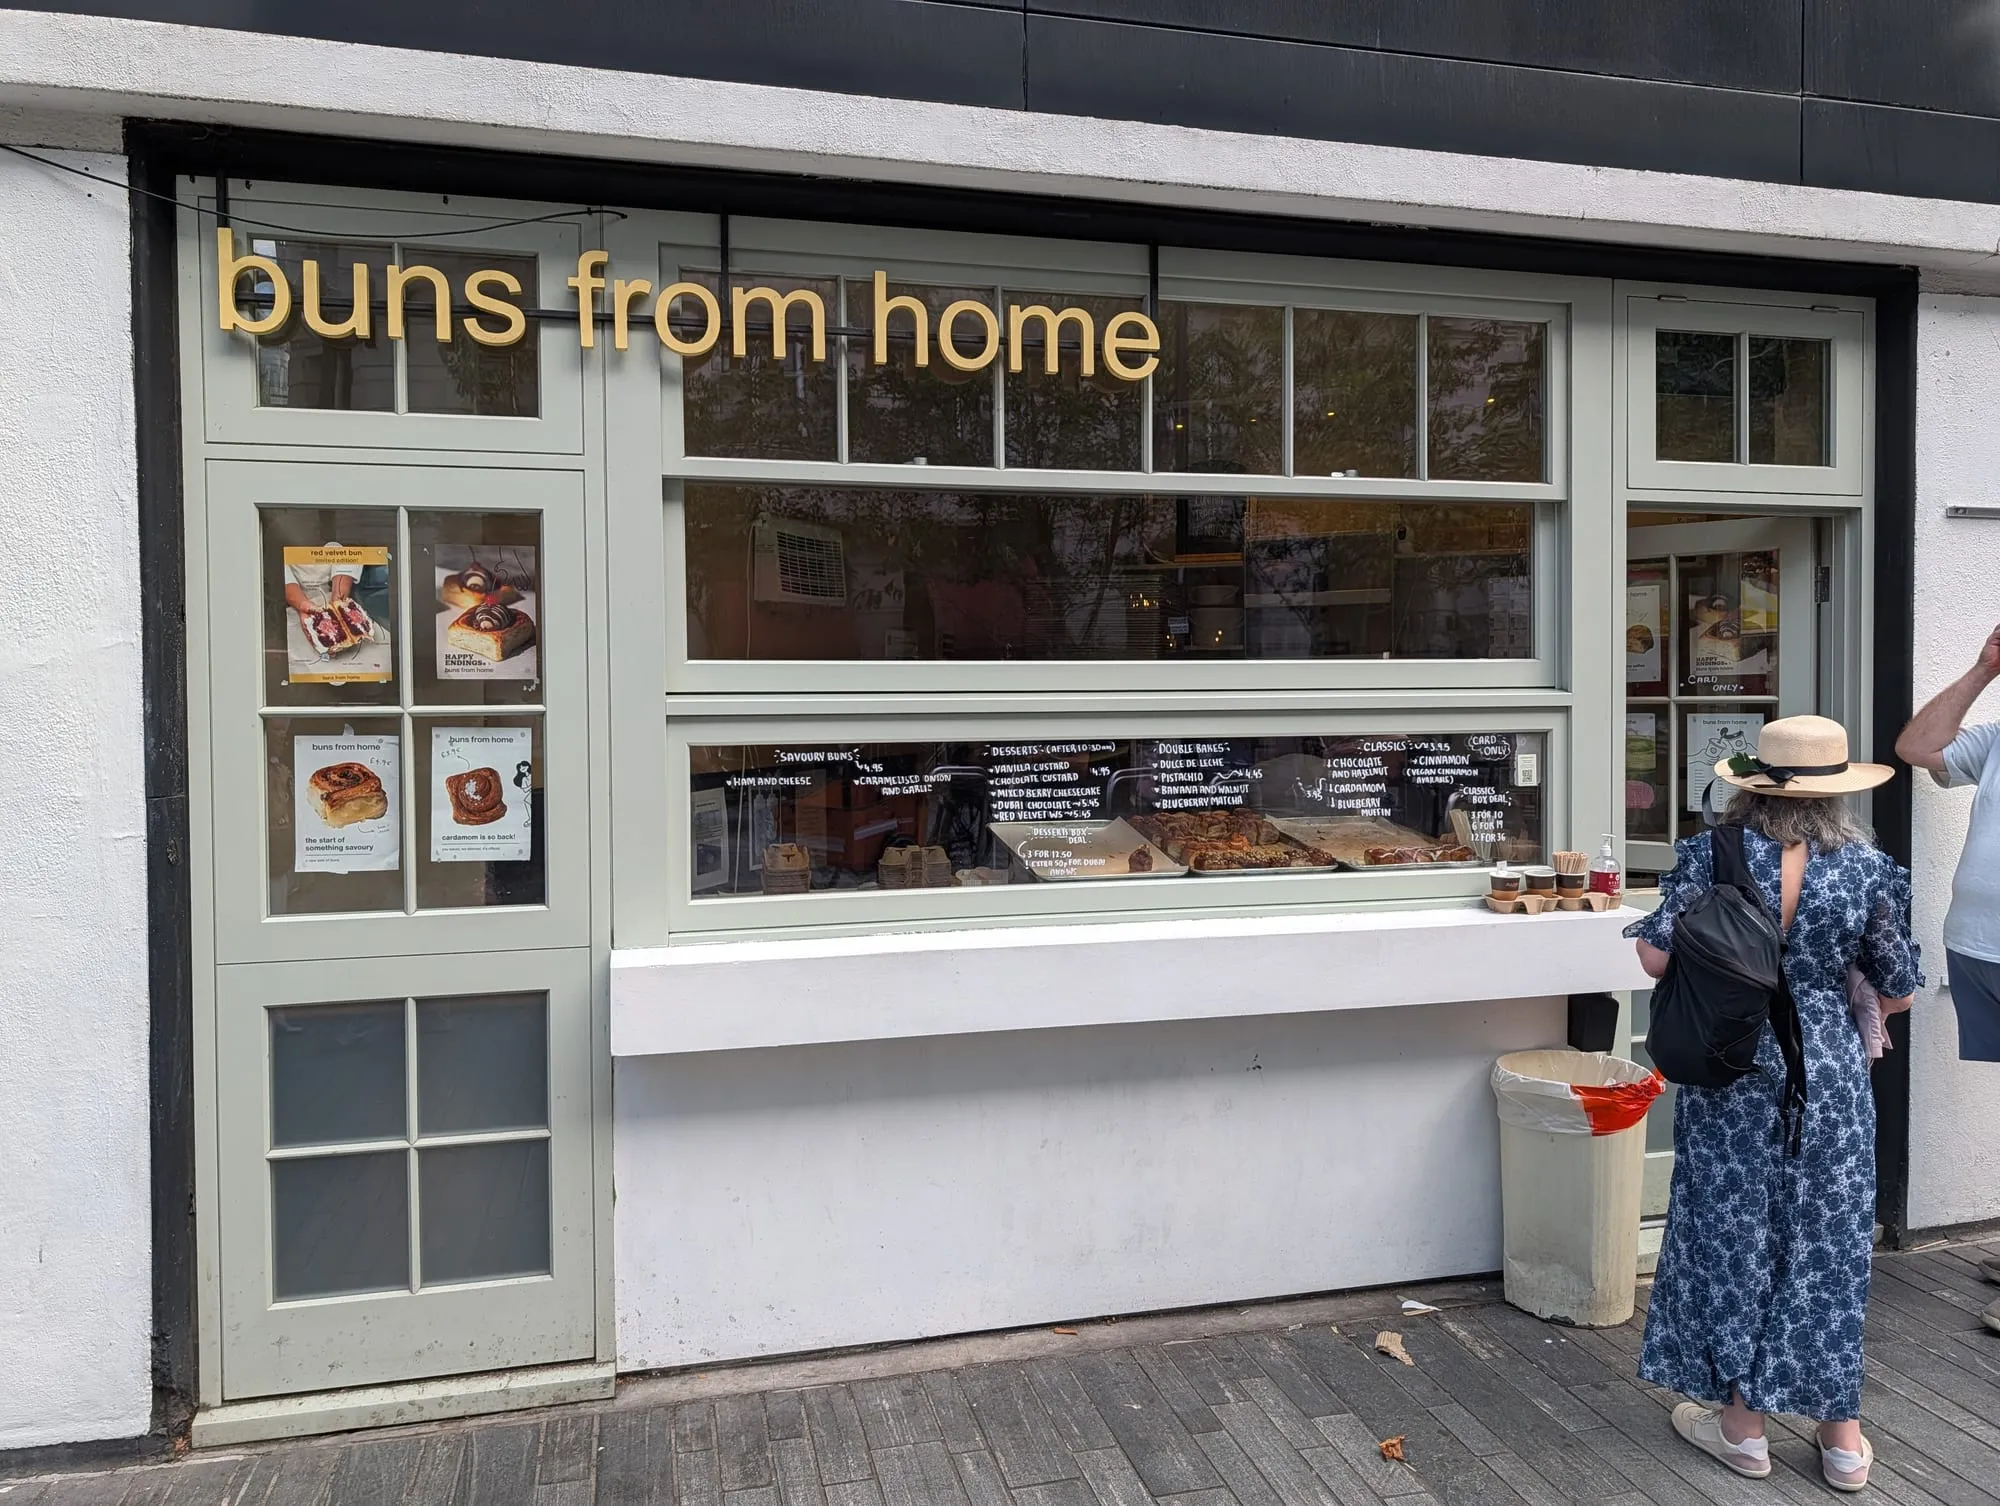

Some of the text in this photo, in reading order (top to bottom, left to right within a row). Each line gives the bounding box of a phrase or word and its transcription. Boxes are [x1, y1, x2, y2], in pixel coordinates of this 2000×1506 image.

[217, 228, 1161, 382] buns from home
[1688, 674, 1718, 684] CARD
[1713, 684, 1738, 692] ONLY
[1472, 736, 1497, 745] CARD
[357, 743, 381, 751] home
[992, 745, 1038, 756] DESSERTS
[1046, 743, 1076, 754] (AFTER
[1159, 743, 1224, 754] DOUBLE BAKES
[1363, 741, 1450, 752] CLASSICS 3.95
[1483, 746, 1507, 755] ONLY
[780, 752, 853, 762] SAVOURY BUNS
[1419, 754, 1471, 765] CINNAMON
[994, 761, 1070, 774] VANILLA CUSTARD
[1160, 758, 1224, 768] DULCE DE LECHE
[1333, 757, 1382, 768] CHOCOLATE
[863, 763, 884, 773] 4.95
[1091, 766, 1111, 776] 4.95
[1332, 766, 1389, 779] AND HAZELNUT
[1406, 768, 1478, 777] (VEGAN CINNAMON
[733, 776, 812, 786] HAM AND CHEESE
[860, 774, 951, 785] CARAMELISED ONION
[995, 773, 1079, 785] CHOCOLATE CUSTARD
[1161, 769, 1263, 783] PISTACHIO 4.45
[881, 784, 933, 795] AND GARLIC
[997, 787, 1101, 798] MIXED BERRY CHEESECAKE
[1161, 784, 1249, 795] BANANA AND WALNUT
[1334, 783, 1387, 793] CARDAMOM
[1463, 786, 1495, 795] CLASSICS
[1306, 790, 1323, 801] 3.95
[1472, 794, 1507, 804] BOX DEAL
[998, 798, 1100, 810] DUBAI CHOCOLATE 5.45
[1162, 795, 1243, 809] BLUEBERRY MATCHA
[1338, 797, 1381, 809] BLUEBERRY
[1000, 810, 1092, 821] RED VELVET WS 5.45
[1361, 808, 1391, 816] MUFFIN
[1471, 811, 1504, 819] 3 FOR 10
[1472, 822, 1477, 830] 6
[1480, 821, 1495, 830] FOR
[1033, 827, 1087, 836] DESSERTS BOX
[1068, 836, 1087, 844] DEAL
[1471, 833, 1506, 842] 12 FOR 36
[305, 844, 344, 852] something
[1027, 850, 1072, 858] 3 FOR 12.50
[1083, 858, 1106, 866] DUBAI
